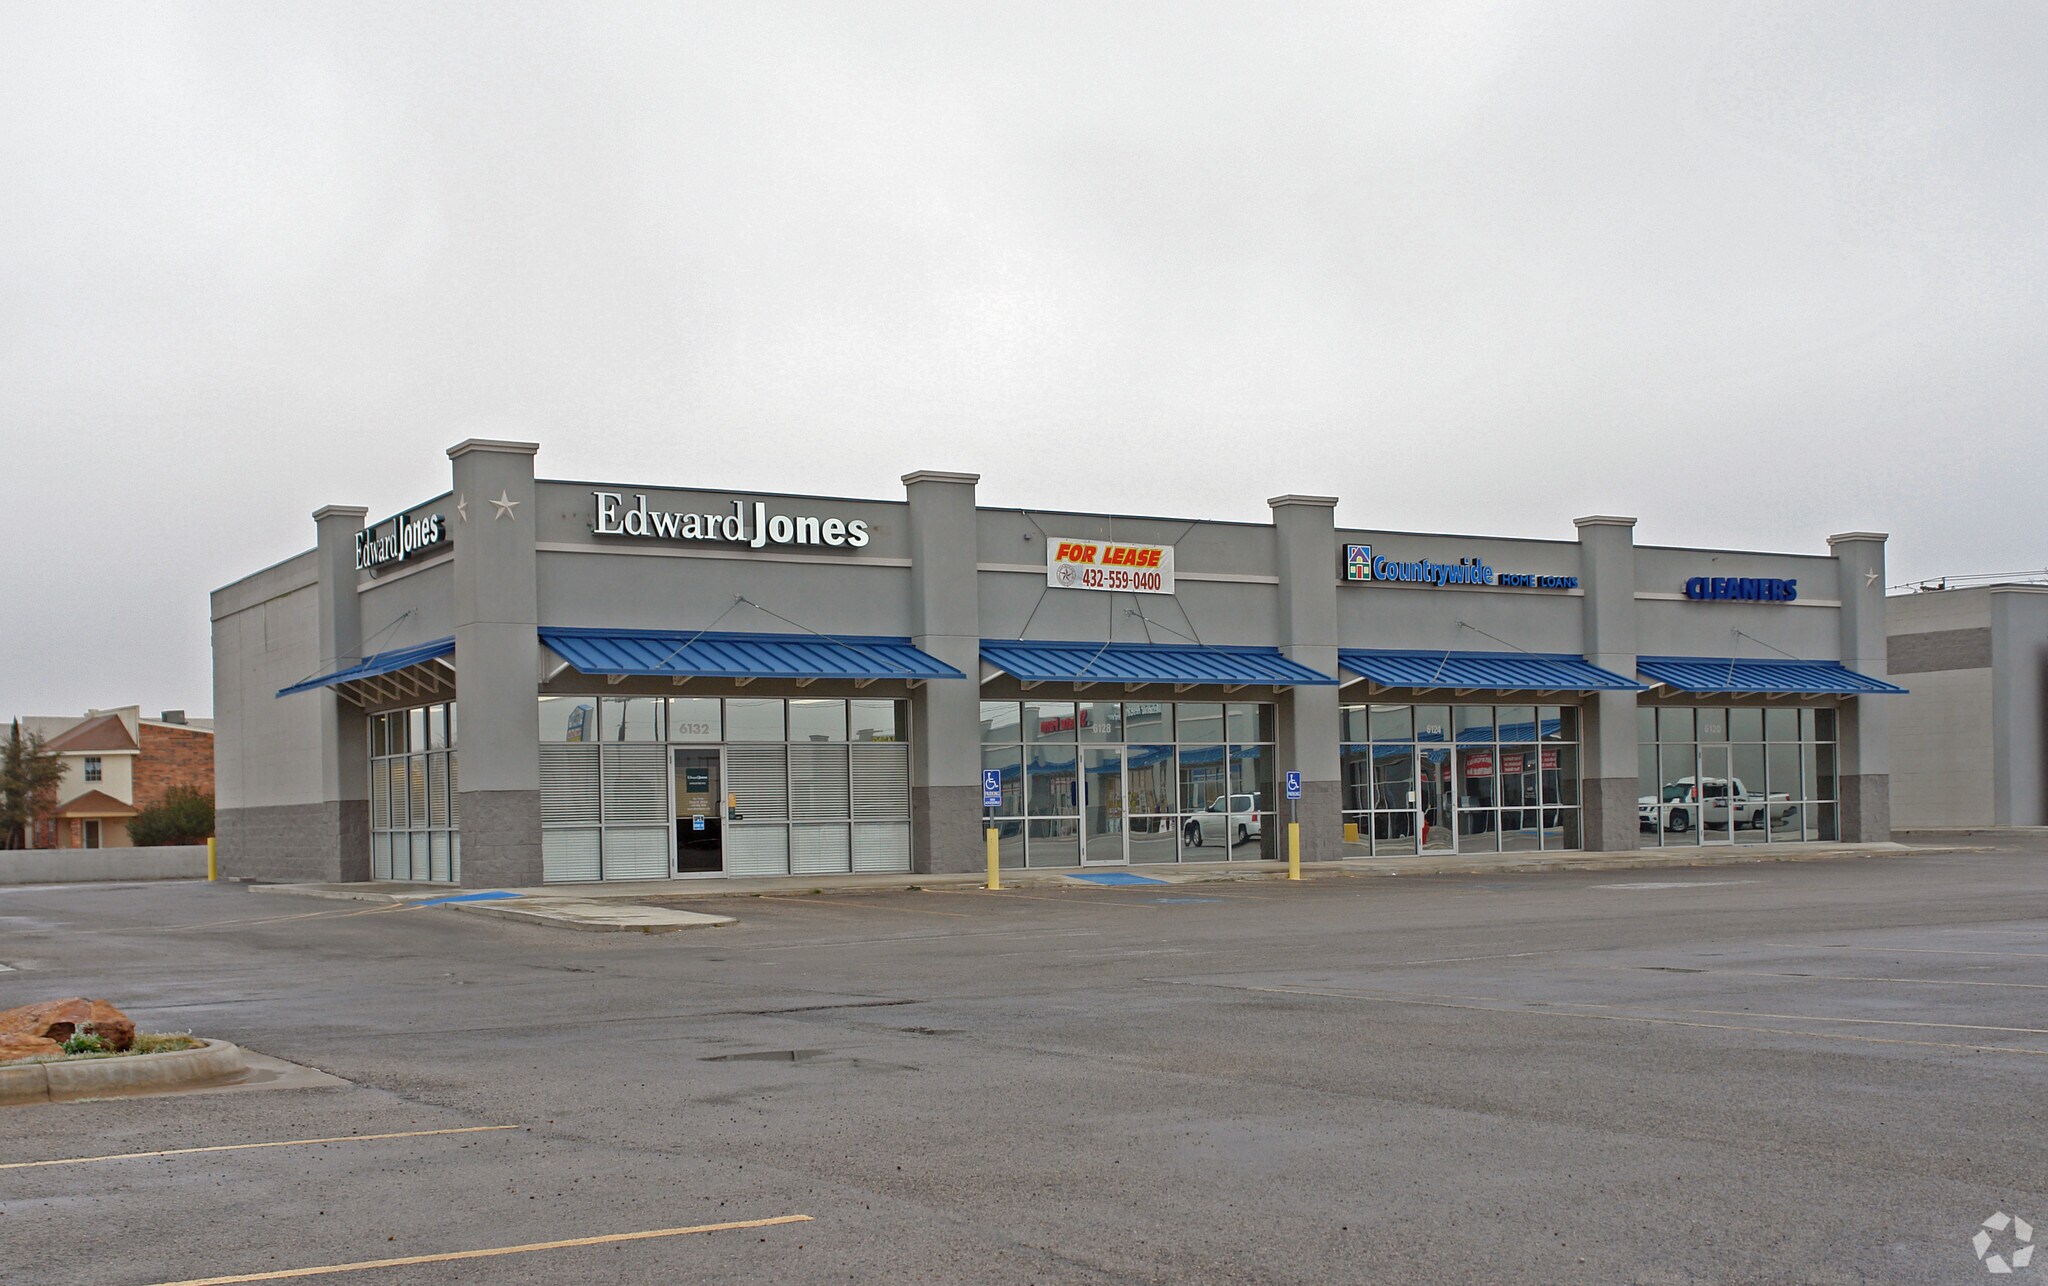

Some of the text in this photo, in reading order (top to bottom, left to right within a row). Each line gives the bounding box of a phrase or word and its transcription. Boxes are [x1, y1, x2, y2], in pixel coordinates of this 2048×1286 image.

[593, 491, 870, 549] Edward Jones
[355, 513, 440, 570] Edward Jones
[1055, 542, 1162, 568] FOR LEASE
[1082, 569, 1161, 591] 432-559-0400
[1373, 555, 1579, 589] Countrywide HOME LOANS
[1685, 577, 1798, 602] CLEANERS
[680, 723, 710, 735] 6132
[1092, 723, 1112, 734] 6128
[1704, 724, 1722, 734] 6120
